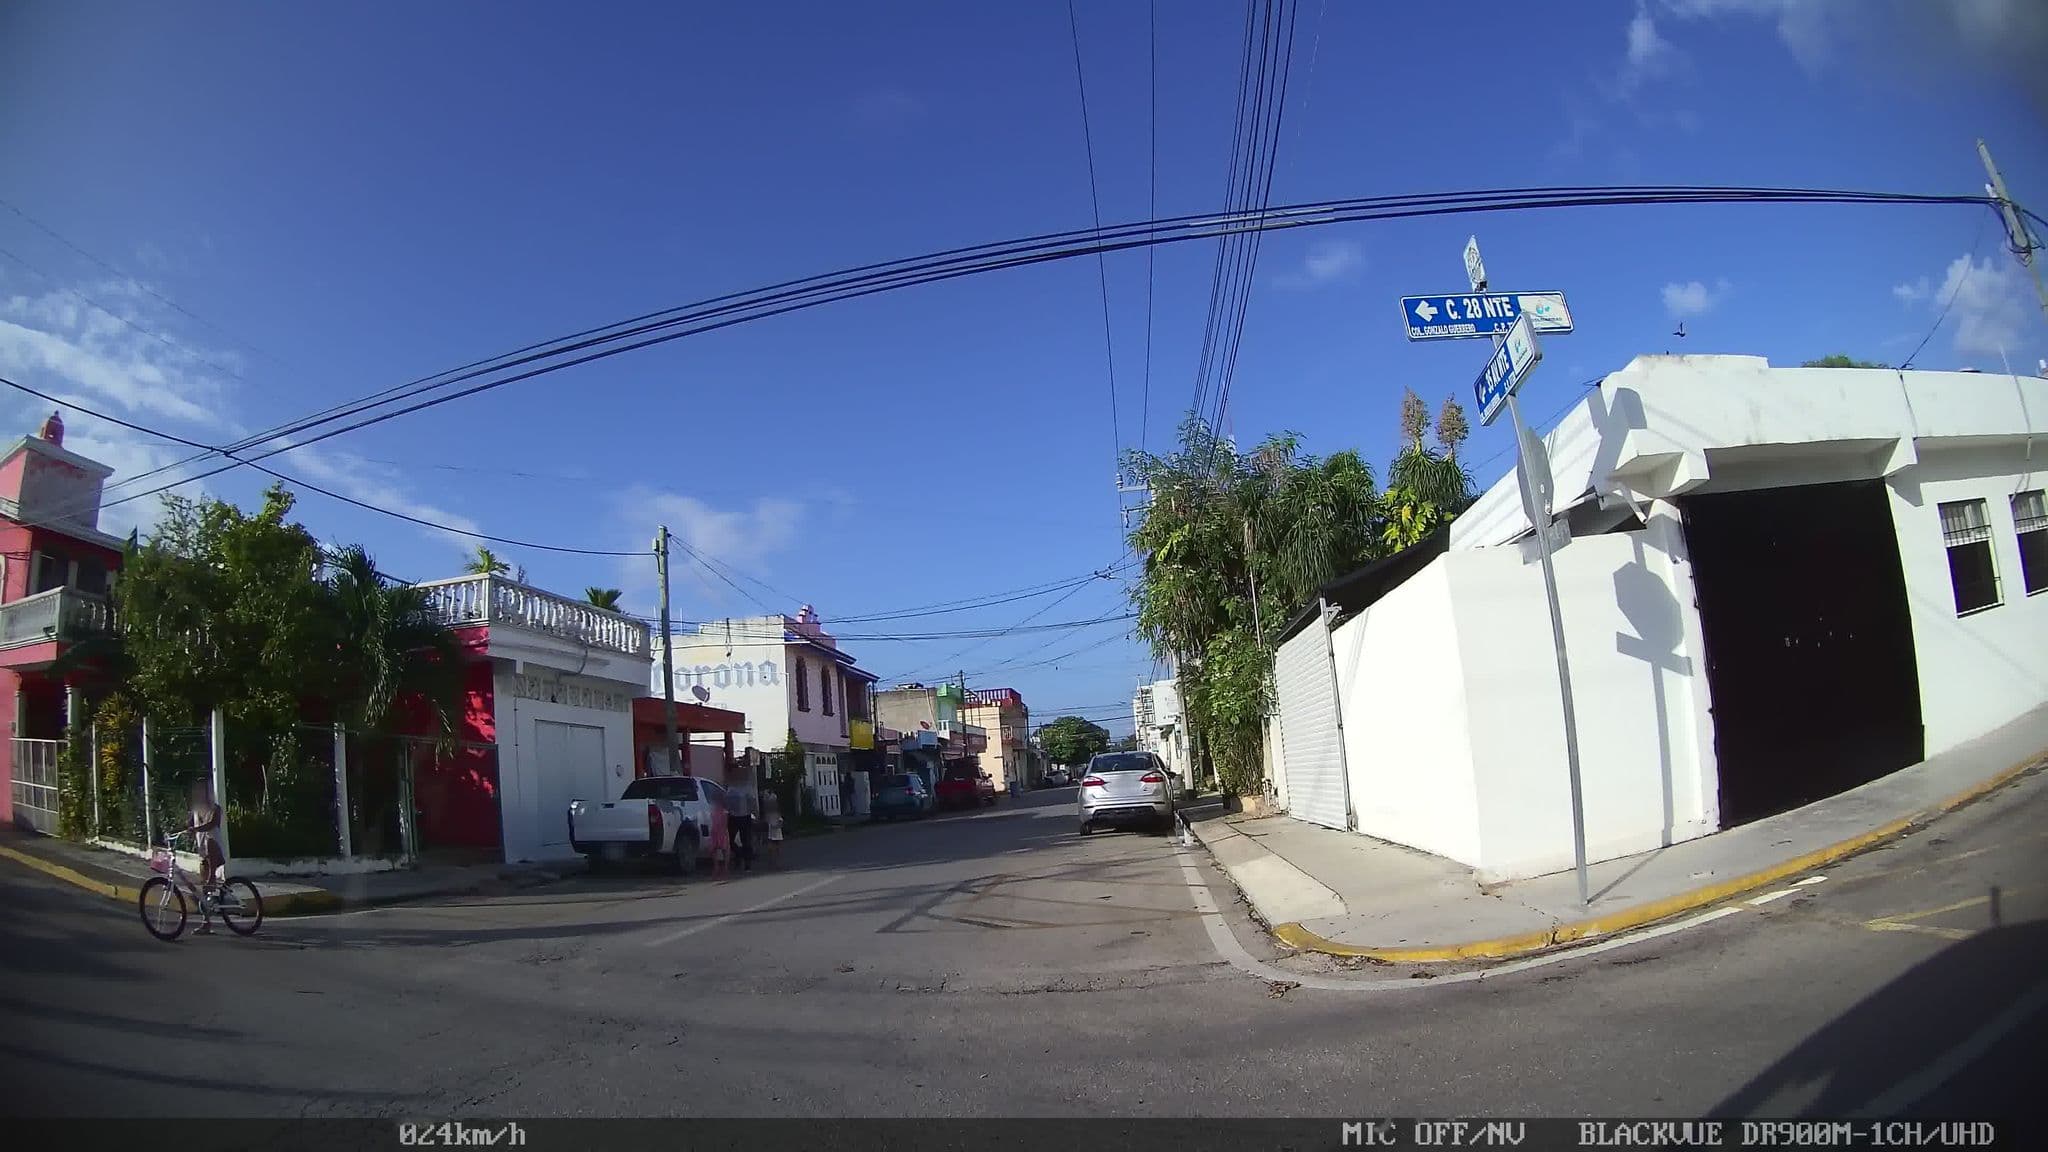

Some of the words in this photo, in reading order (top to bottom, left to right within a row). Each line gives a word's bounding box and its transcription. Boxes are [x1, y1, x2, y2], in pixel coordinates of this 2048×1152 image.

[1446, 298, 1461, 320] C.
[1463, 298, 1482, 319] 28
[1483, 296, 1514, 318] NTE
[1411, 326, 1424, 336] COL.
[1424, 325, 1448, 335] GONZALO
